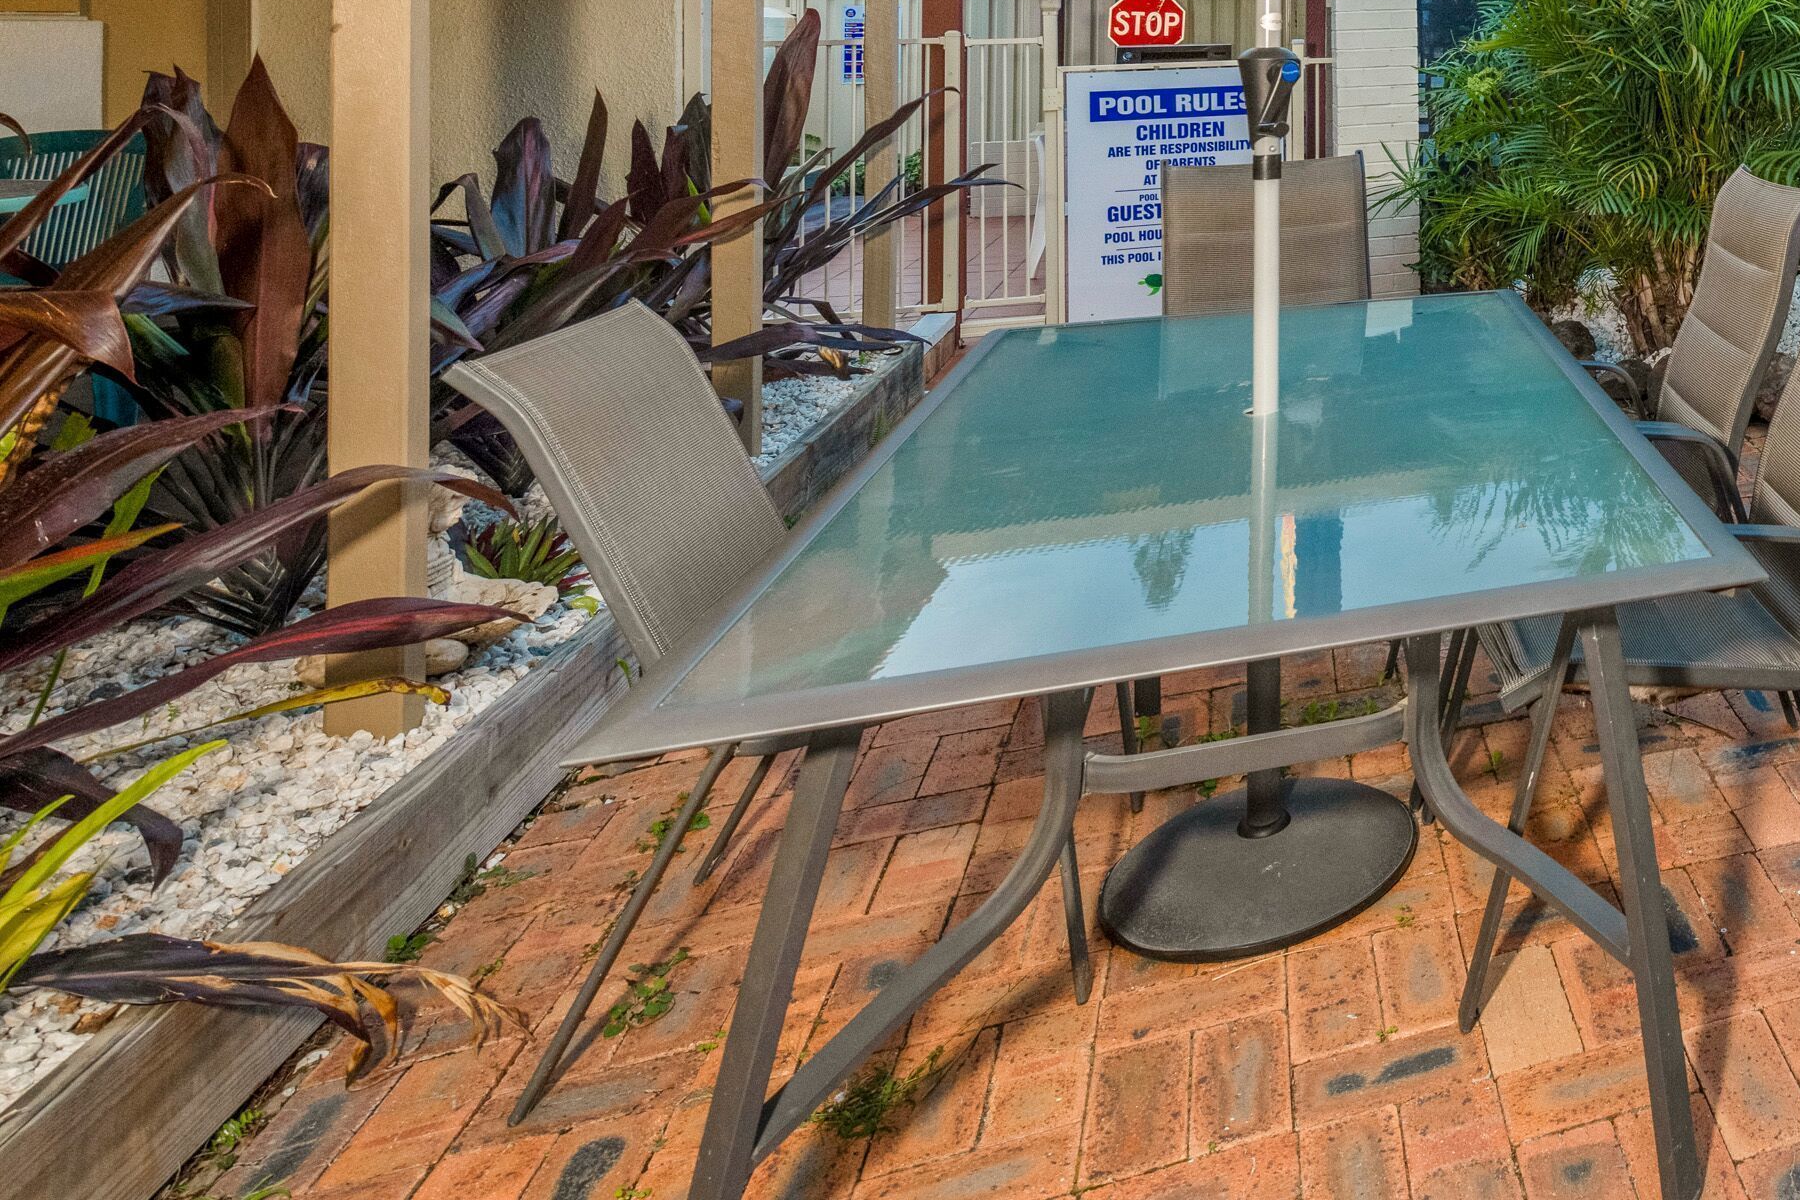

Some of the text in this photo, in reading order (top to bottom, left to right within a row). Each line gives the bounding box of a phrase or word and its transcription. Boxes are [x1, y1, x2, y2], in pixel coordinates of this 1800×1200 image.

[1113, 10, 1180, 37] STOP
[1099, 94, 1167, 116] POOL
[1136, 121, 1225, 141] CHILDREN
[1107, 139, 1251, 158] ARE THE RESPONSIBILITY
[1145, 159, 1160, 170] OF
[1143, 174, 1157, 186] AT
[1139, 193, 1159, 201] POOL
[1104, 229, 1162, 244] POOL HOU
[1101, 254, 1125, 265] THIS
[1127, 251, 1155, 263] POOL
